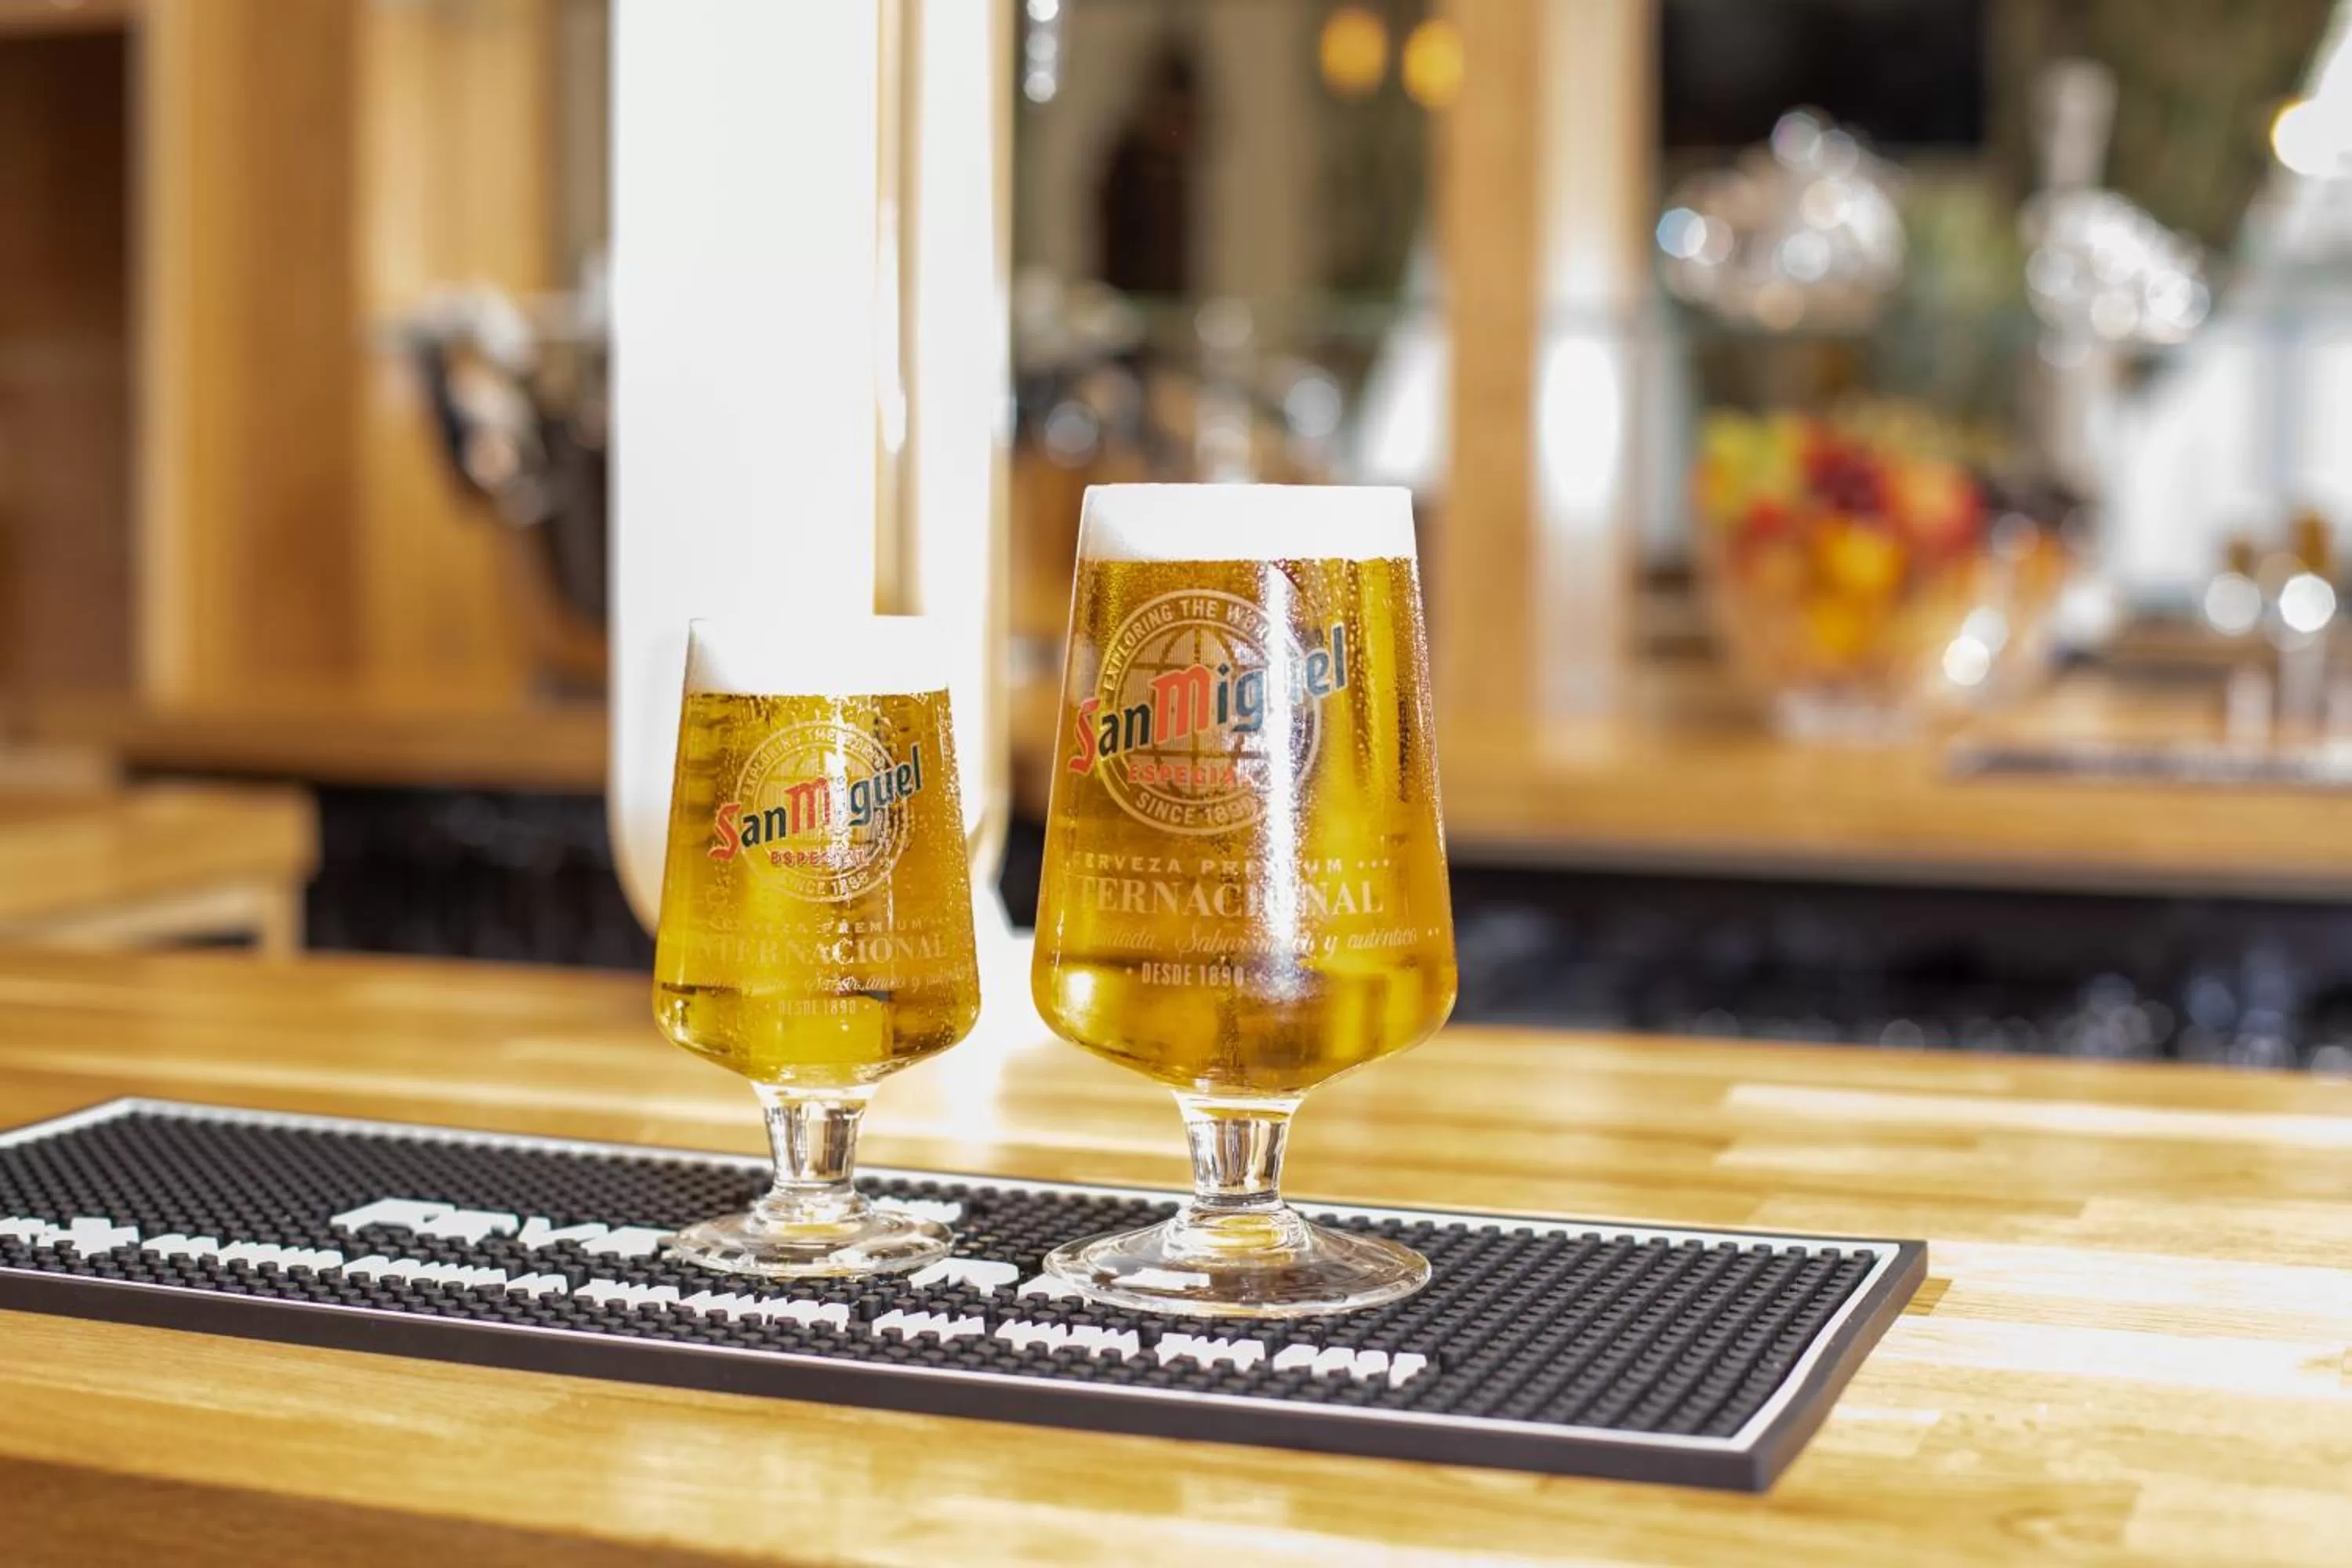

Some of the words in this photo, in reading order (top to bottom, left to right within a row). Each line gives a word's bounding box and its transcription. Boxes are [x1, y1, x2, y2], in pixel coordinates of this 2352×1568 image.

[1103, 604, 1174, 691] EXPLORING
[1178, 598, 1218, 618] THE
[805, 727, 837, 742] THE
[1135, 791, 1196, 825] SINCE
[1200, 858, 1342, 878] PREUM
[1142, 961, 1192, 986] DESDE
[1199, 964, 1246, 988] 1890
[823, 999, 857, 1017] 1890
